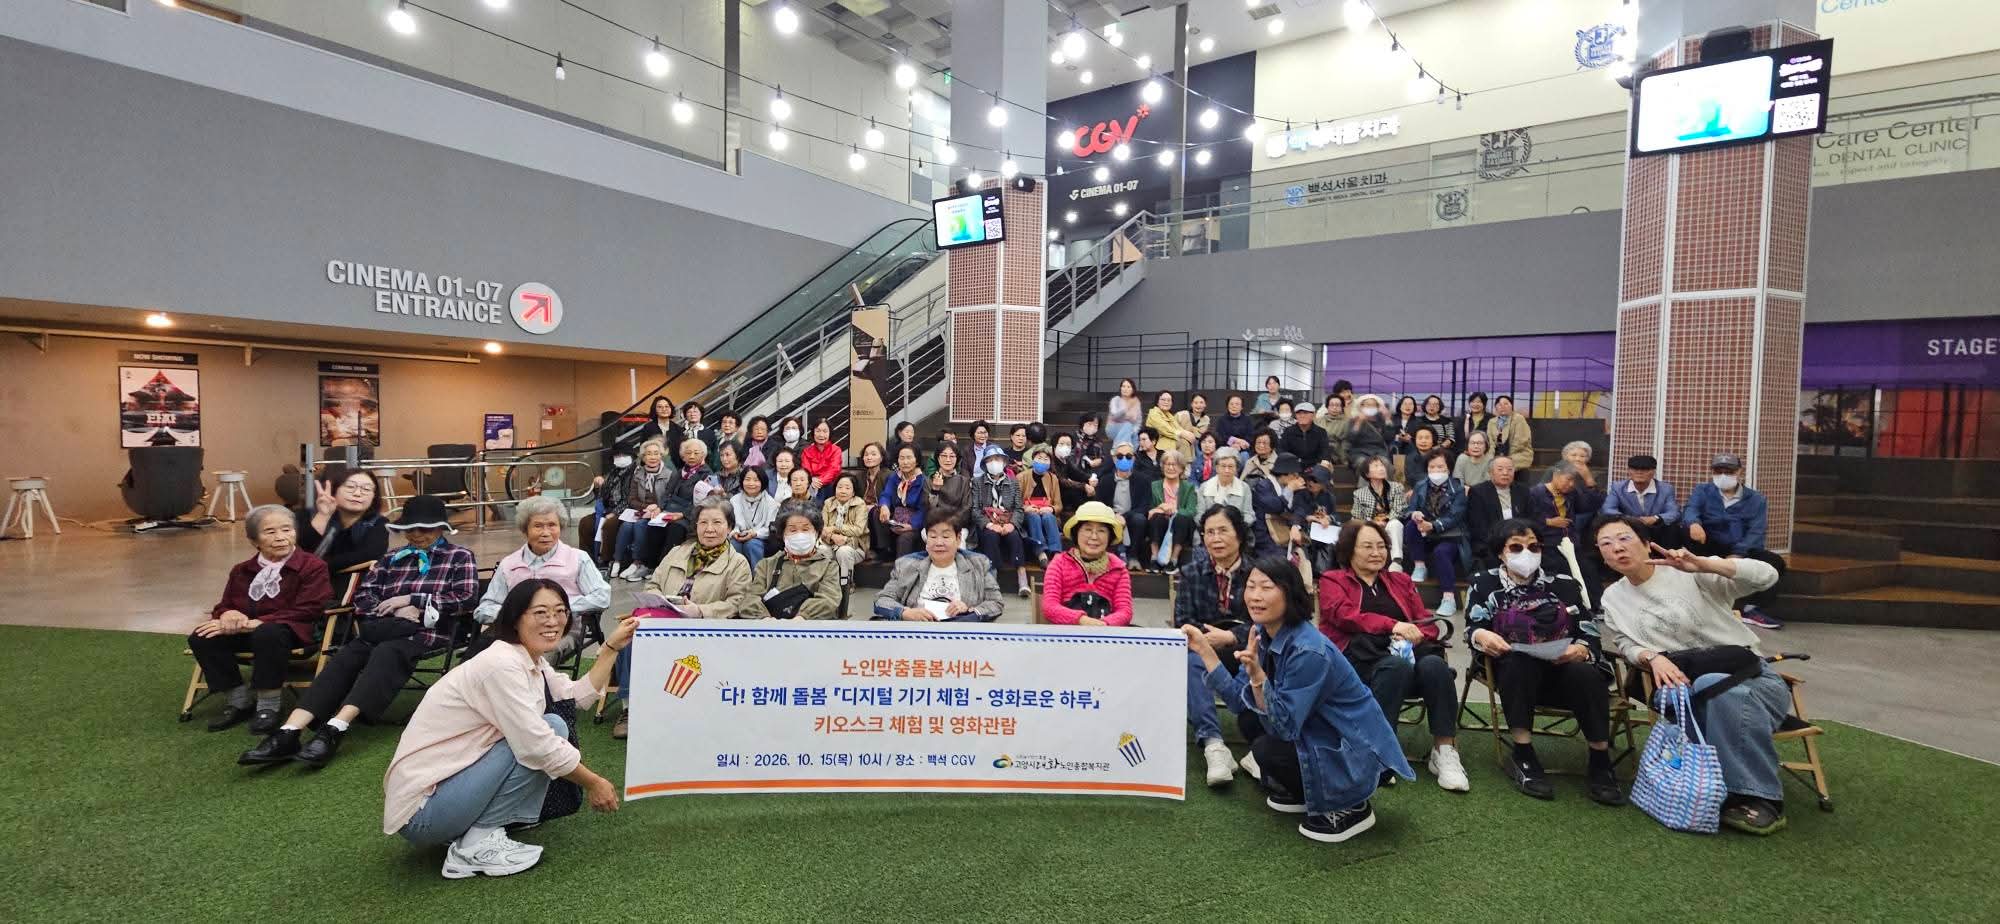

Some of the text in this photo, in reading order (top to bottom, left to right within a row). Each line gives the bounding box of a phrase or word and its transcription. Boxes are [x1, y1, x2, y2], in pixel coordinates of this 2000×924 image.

[1073, 115, 1139, 157] CGV
[1816, 116, 1980, 149] Care Center
[1829, 147, 1897, 165] DENTAL
[1905, 138, 1969, 156] CLINIC
[1081, 180, 1139, 198] CINEMA 01-07
[1308, 172, 1388, 193] 백석서울치과
[327, 260, 504, 302] CINEMA 01-07
[376, 290, 502, 324] ENTRANCE
[841, 659, 995, 678] 노인맞춤돌봄서비스
[720, 687, 746, 706] 다!
[752, 687, 788, 706] 함께
[792, 687, 828, 706] 돌봄
[898, 688, 931, 707] 기기
[936, 688, 969, 707] 체험
[988, 688, 1055, 708] 영화로운
[815, 716, 1017, 736] 키오스크 체험 및 영화관람
[717, 754, 740, 767] 일시
[755, 754, 791, 767] 2026.
[798, 754, 814, 767] 10.
[821, 753, 853, 767] 15(목)
[858, 753, 882, 767] 10시
[895, 754, 915, 767] 장소
[927, 754, 947, 767] 백석
[951, 754, 976, 766] CGV
